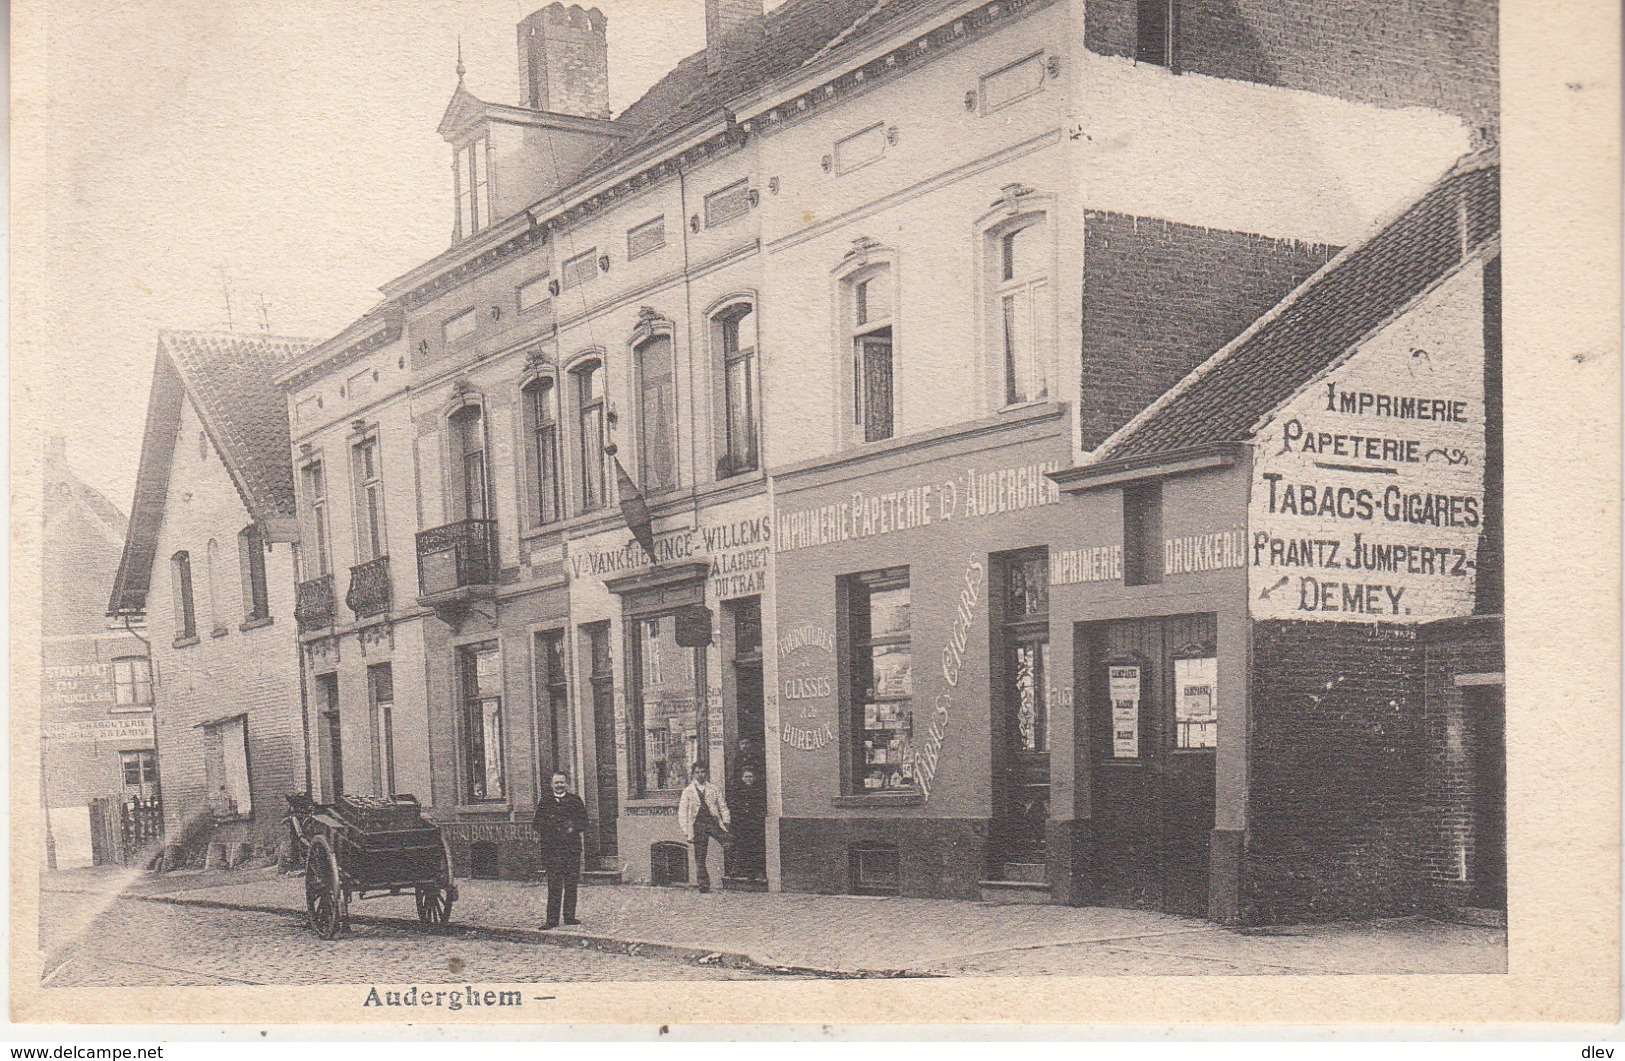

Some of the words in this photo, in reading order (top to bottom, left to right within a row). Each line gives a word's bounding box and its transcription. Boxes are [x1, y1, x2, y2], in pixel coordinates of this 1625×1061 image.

[1326, 381, 1467, 423] IMPRIMERIE
[1276, 419, 1420, 463] PAPETERIE
[777, 502, 848, 551] IMPRIMERIE
[852, 486, 931, 538] PAPETERIE
[1051, 546, 1121, 585] IMPRIMERIE
[1253, 531, 1341, 568] FRANTZ
[715, 577, 728, 597] DU
[731, 571, 765, 595] TRAM
[785, 677, 831, 700] CLASSES
[783, 722, 833, 750] BUREAUX
[471, 823, 494, 841] BON
